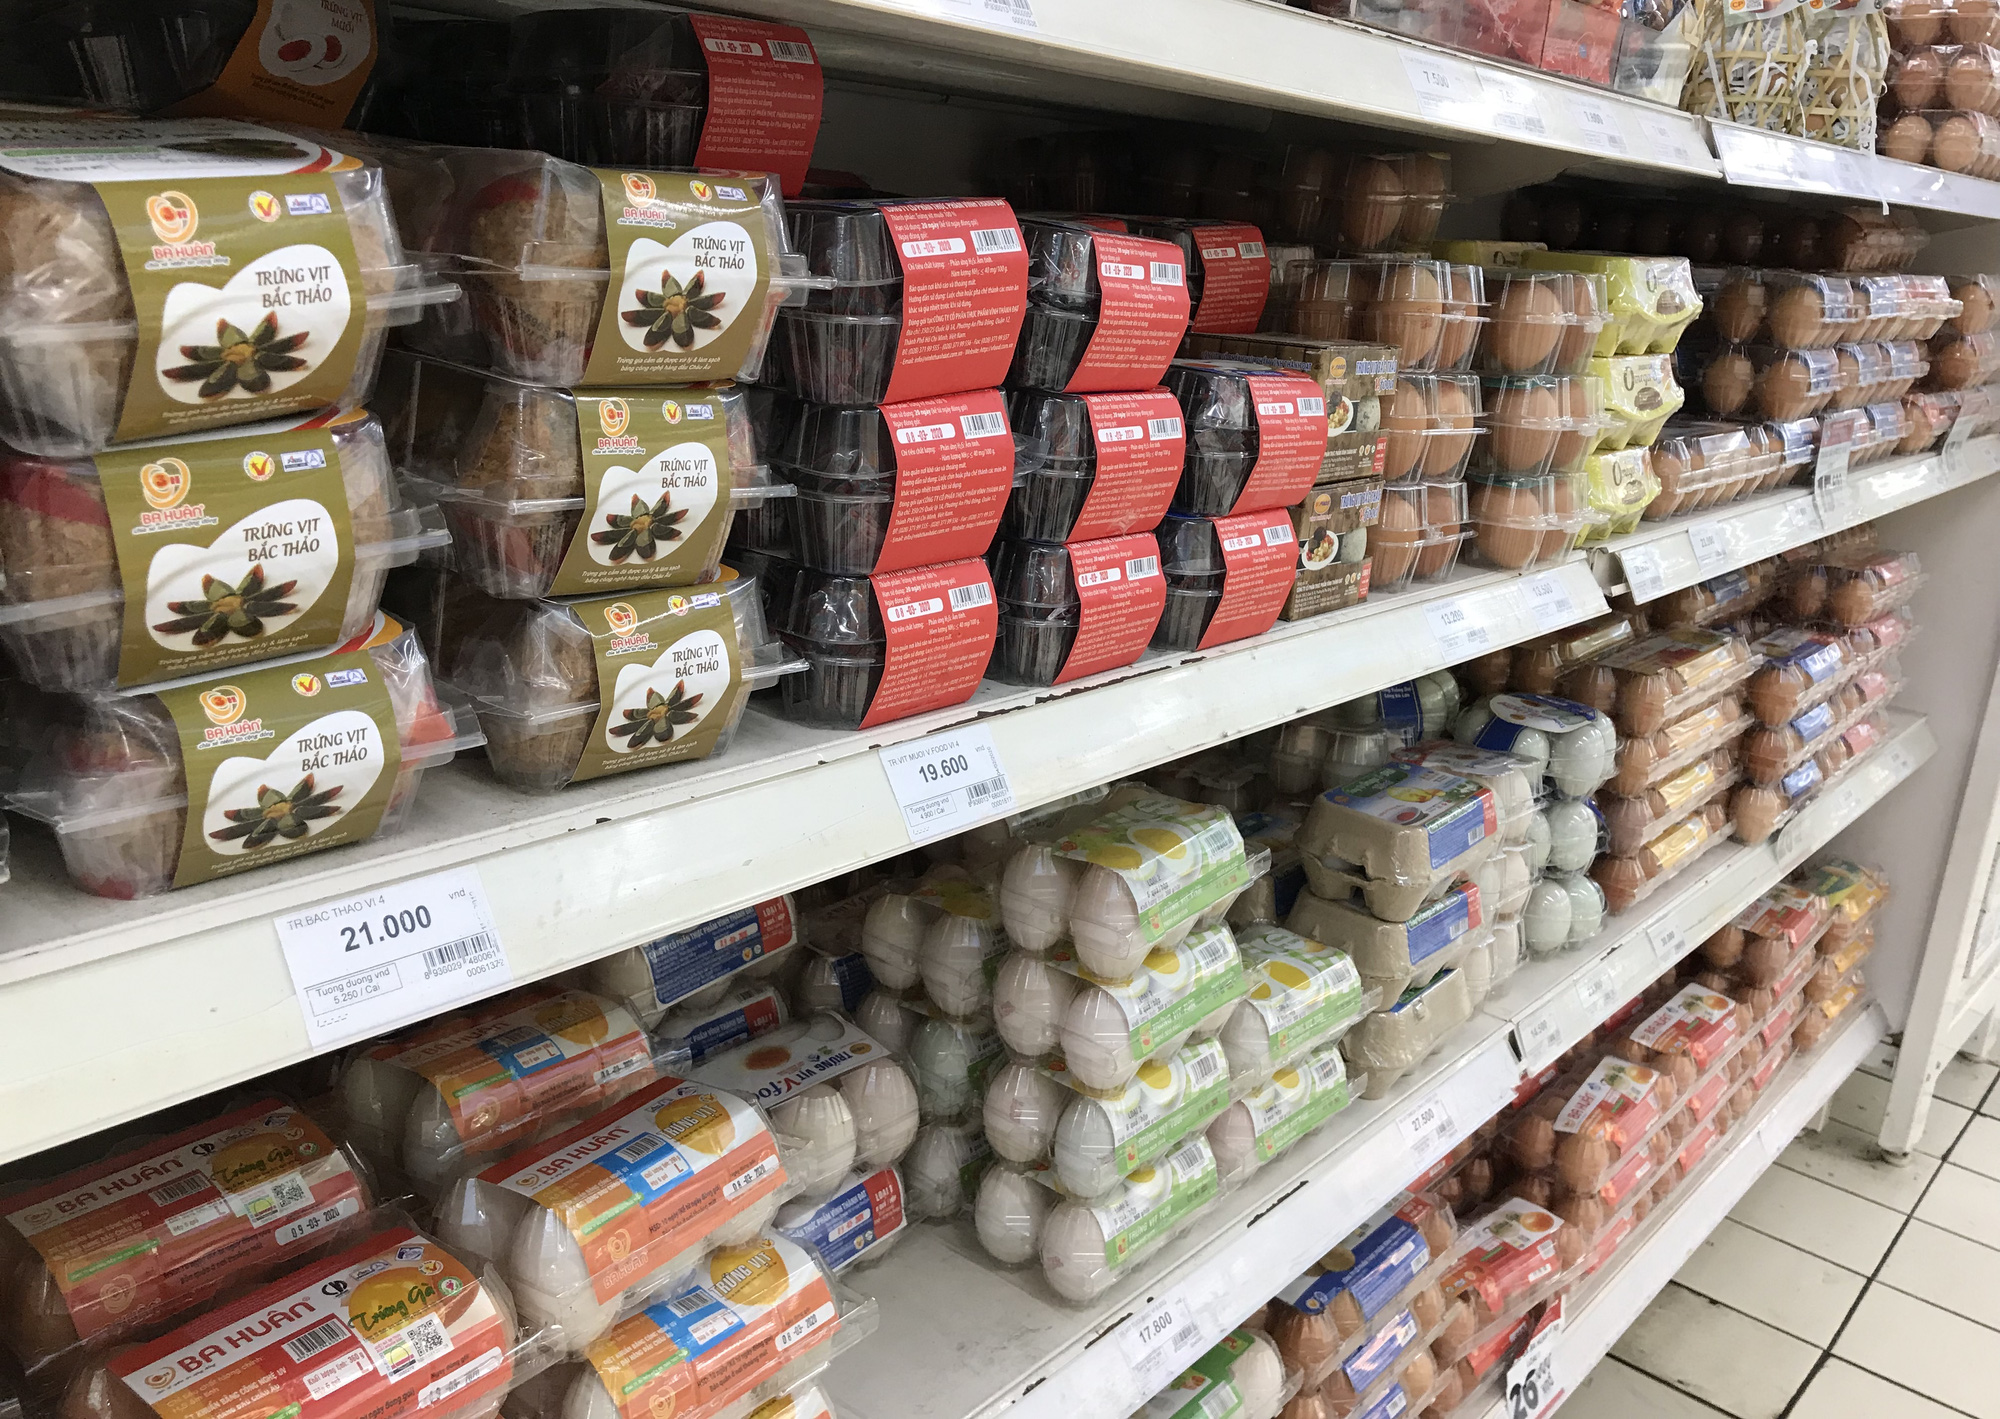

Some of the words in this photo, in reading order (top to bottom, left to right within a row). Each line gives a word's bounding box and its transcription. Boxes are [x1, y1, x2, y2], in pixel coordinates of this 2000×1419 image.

[624, 208, 637, 217] BA
[692, 236, 726, 250] TRỨNG
[729, 240, 745, 252] VỊT
[695, 251, 715, 268] BẮC
[718, 255, 745, 270] THẢO
[308, 266, 331, 283] VỊT
[295, 284, 332, 305] THẢO
[599, 439, 611, 447] BA
[660, 457, 691, 472] TRỨNG
[694, 460, 708, 473] VỊT
[662, 473, 680, 488] BẮC
[683, 472, 707, 487] THẢO
[143, 512, 162, 525] BA
[165, 505, 202, 521] HUÂN
[243, 522, 293, 542] TRỨNG
[297, 518, 320, 536] VỊT
[248, 540, 278, 561] BẮC
[283, 537, 320, 556] THẢO
[612, 640, 623, 648] BA
[672, 646, 702, 662] TRỨNG
[705, 644, 719, 657] VỊT
[675, 662, 693, 678] BẮC
[696, 658, 719, 674] THẢO
[206, 728, 224, 740] BA
[226, 720, 260, 735] HUÂN
[297, 732, 342, 753] TRỨNG
[347, 727, 367, 746] VỊT
[302, 752, 328, 772] BẮC
[333, 745, 367, 765] THẢO
[919, 754, 969, 783] 19.600
[975, 745, 985, 753] vnd
[331, 901, 363, 917] THAO
[364, 897, 377, 908] VI
[378, 895, 386, 905] 4
[340, 905, 432, 952] 21.000
[449, 888, 466, 900] vnd
[468, 952, 497, 965] 480061
[315, 982, 344, 998] Tuong
[346, 973, 373, 988] duong
[375, 968, 390, 980] vnd
[366, 984, 381, 995] Cai
[656, 1116, 698, 1141] TRỨNG
[694, 1104, 718, 1122] VỊT
[1411, 1108, 1435, 1131] 27.500
[536, 1157, 573, 1176] BA
[568, 1128, 629, 1160] HUÂN
[675, 1163, 684, 1174] L
[55, 1192, 98, 1215] BA
[99, 1155, 184, 1193] HUÂN
[325, 1207, 340, 1223] 2020
[708, 1264, 753, 1298] TRỨNG
[749, 1250, 773, 1268] VỊT
[806, 1313, 818, 1329] 2020
[1139, 1311, 1172, 1343] 17.800
[177, 1344, 227, 1373] BA
[225, 1302, 316, 1349] HUÂN
[1508, 1369, 1539, 1419] 26
